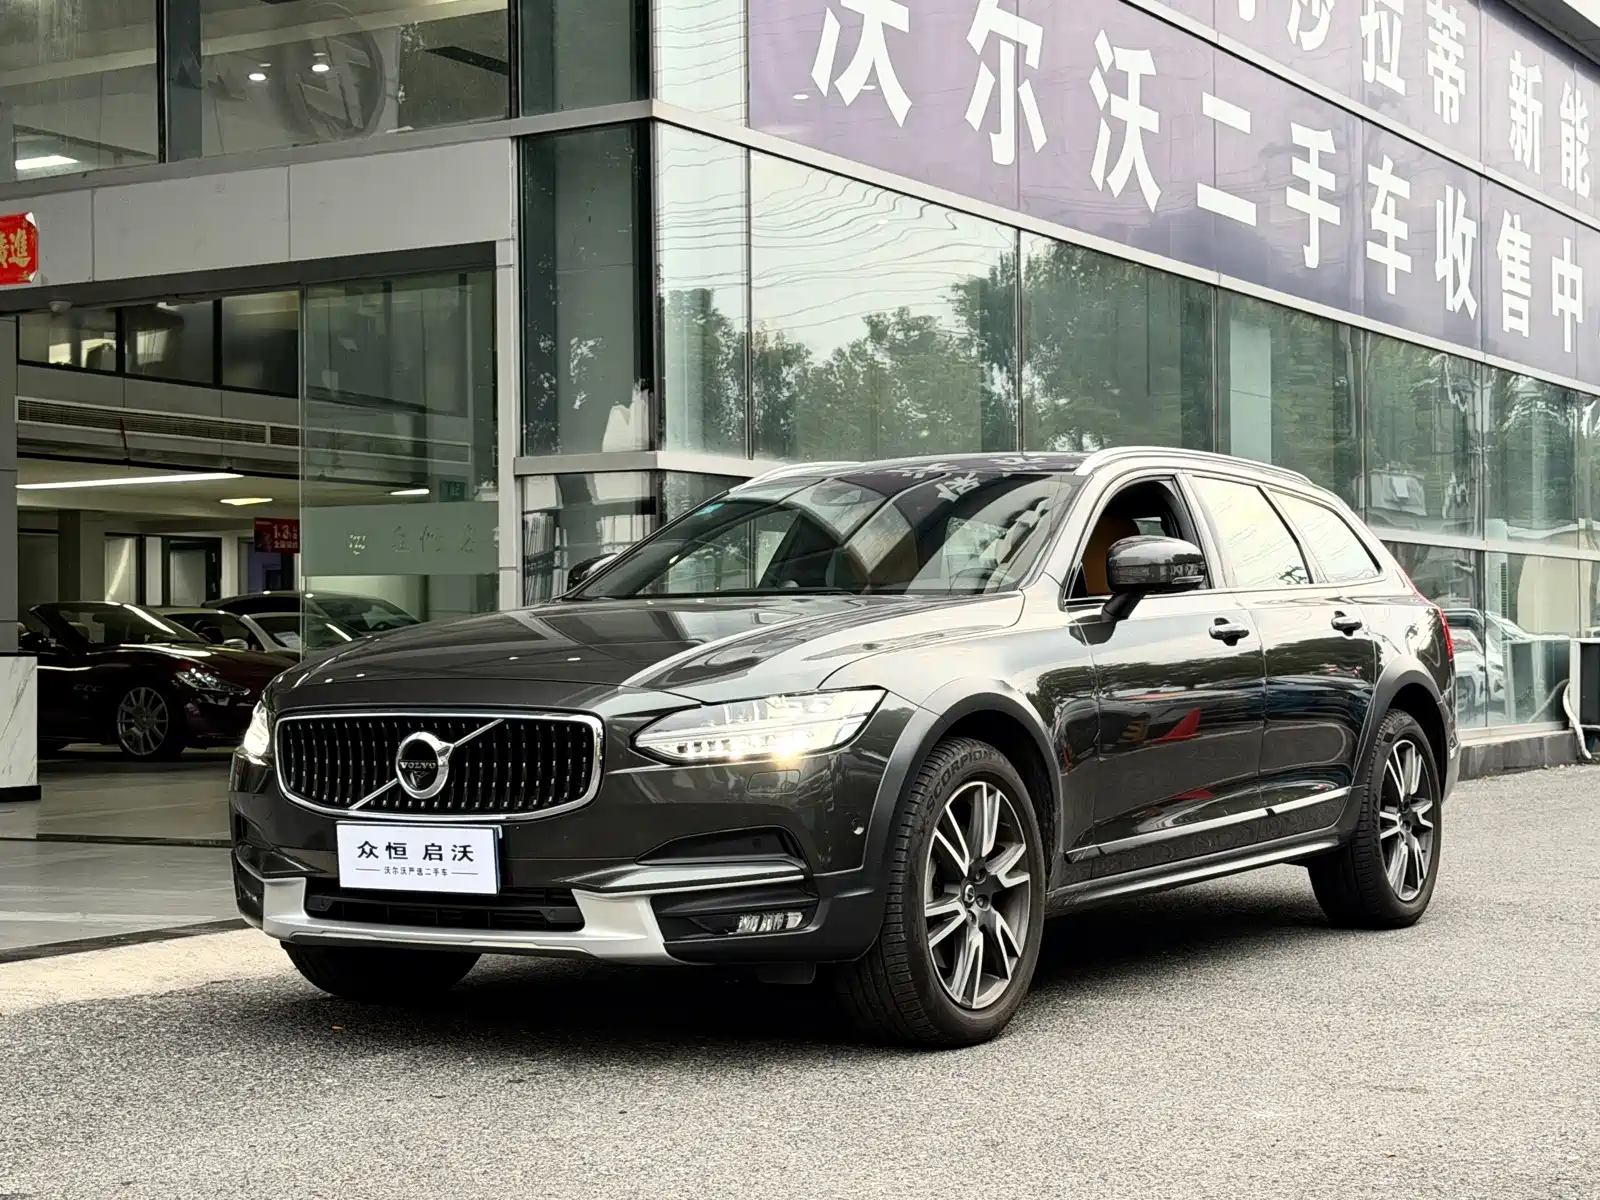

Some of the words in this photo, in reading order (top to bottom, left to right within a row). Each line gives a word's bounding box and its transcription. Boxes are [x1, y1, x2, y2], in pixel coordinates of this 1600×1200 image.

[399, 761, 437, 769] VOLVO
[357, 840, 408, 860] 众恒
[422, 843, 474, 862] 启沃
[384, 866, 448, 877] 沃尔沃严选二手车
